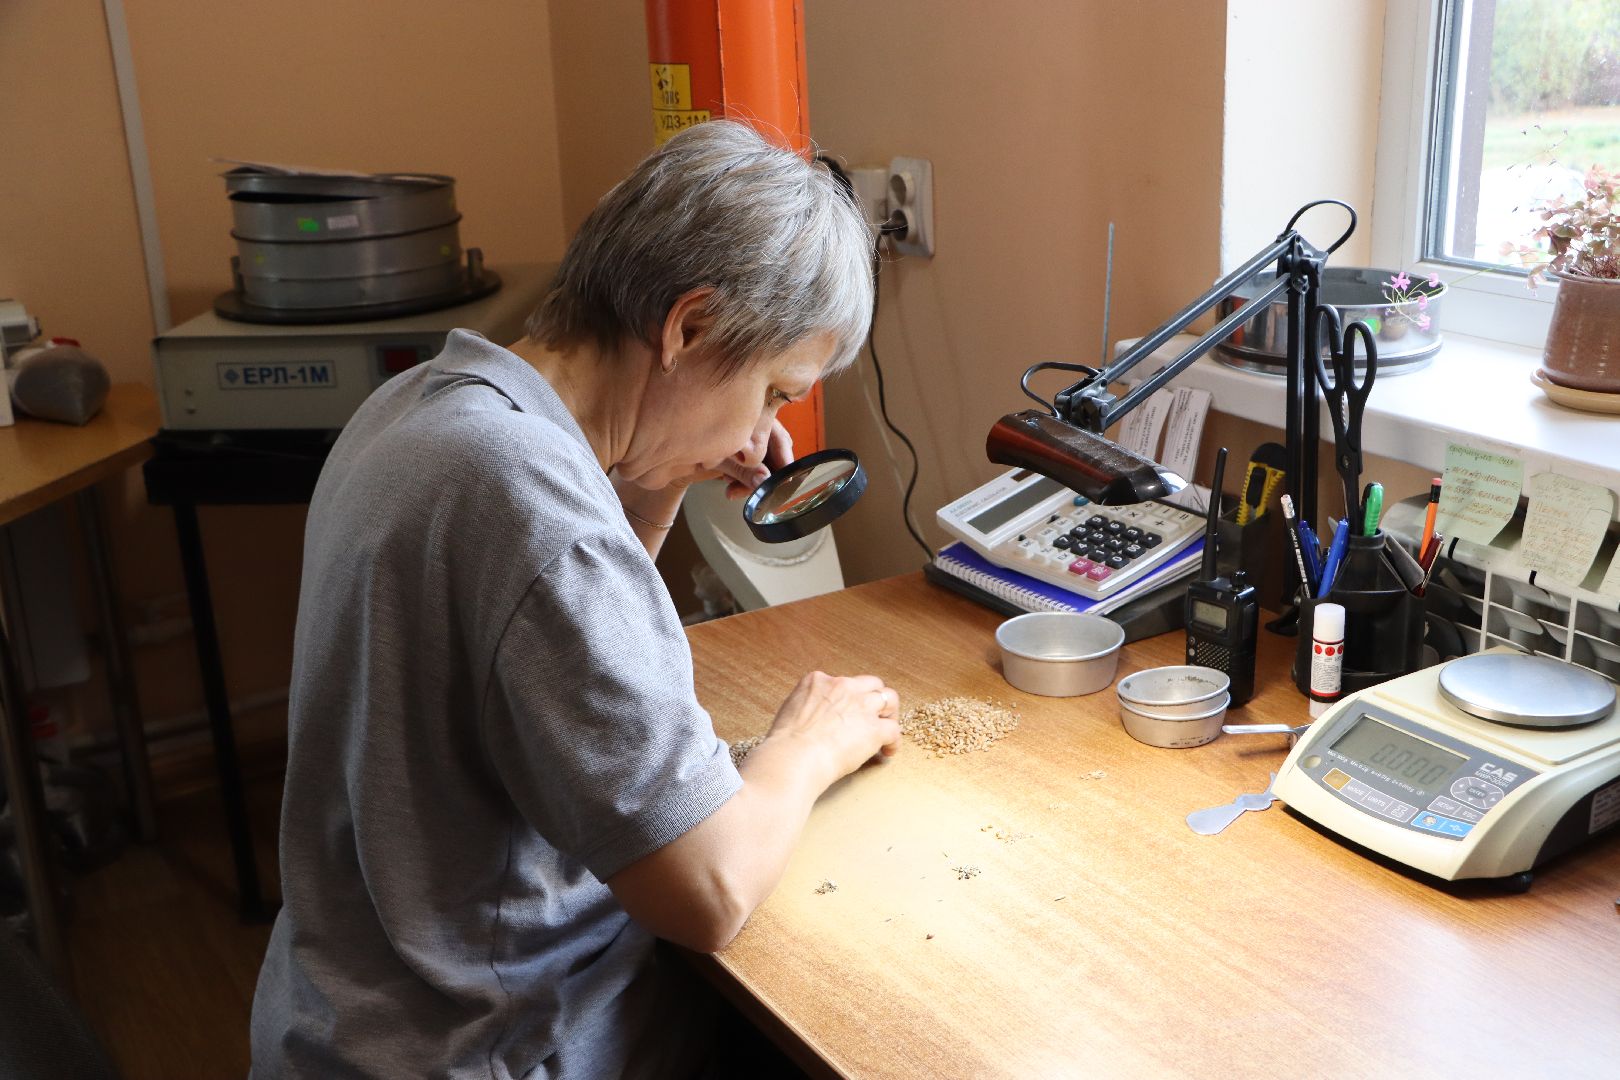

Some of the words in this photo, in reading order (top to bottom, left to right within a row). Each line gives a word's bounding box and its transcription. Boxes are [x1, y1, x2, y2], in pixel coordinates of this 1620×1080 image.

[243, 366, 330, 385] ЕРЛ-1М
[1127, 544, 1141, 552] 00
[1479, 763, 1518, 782] CAS
